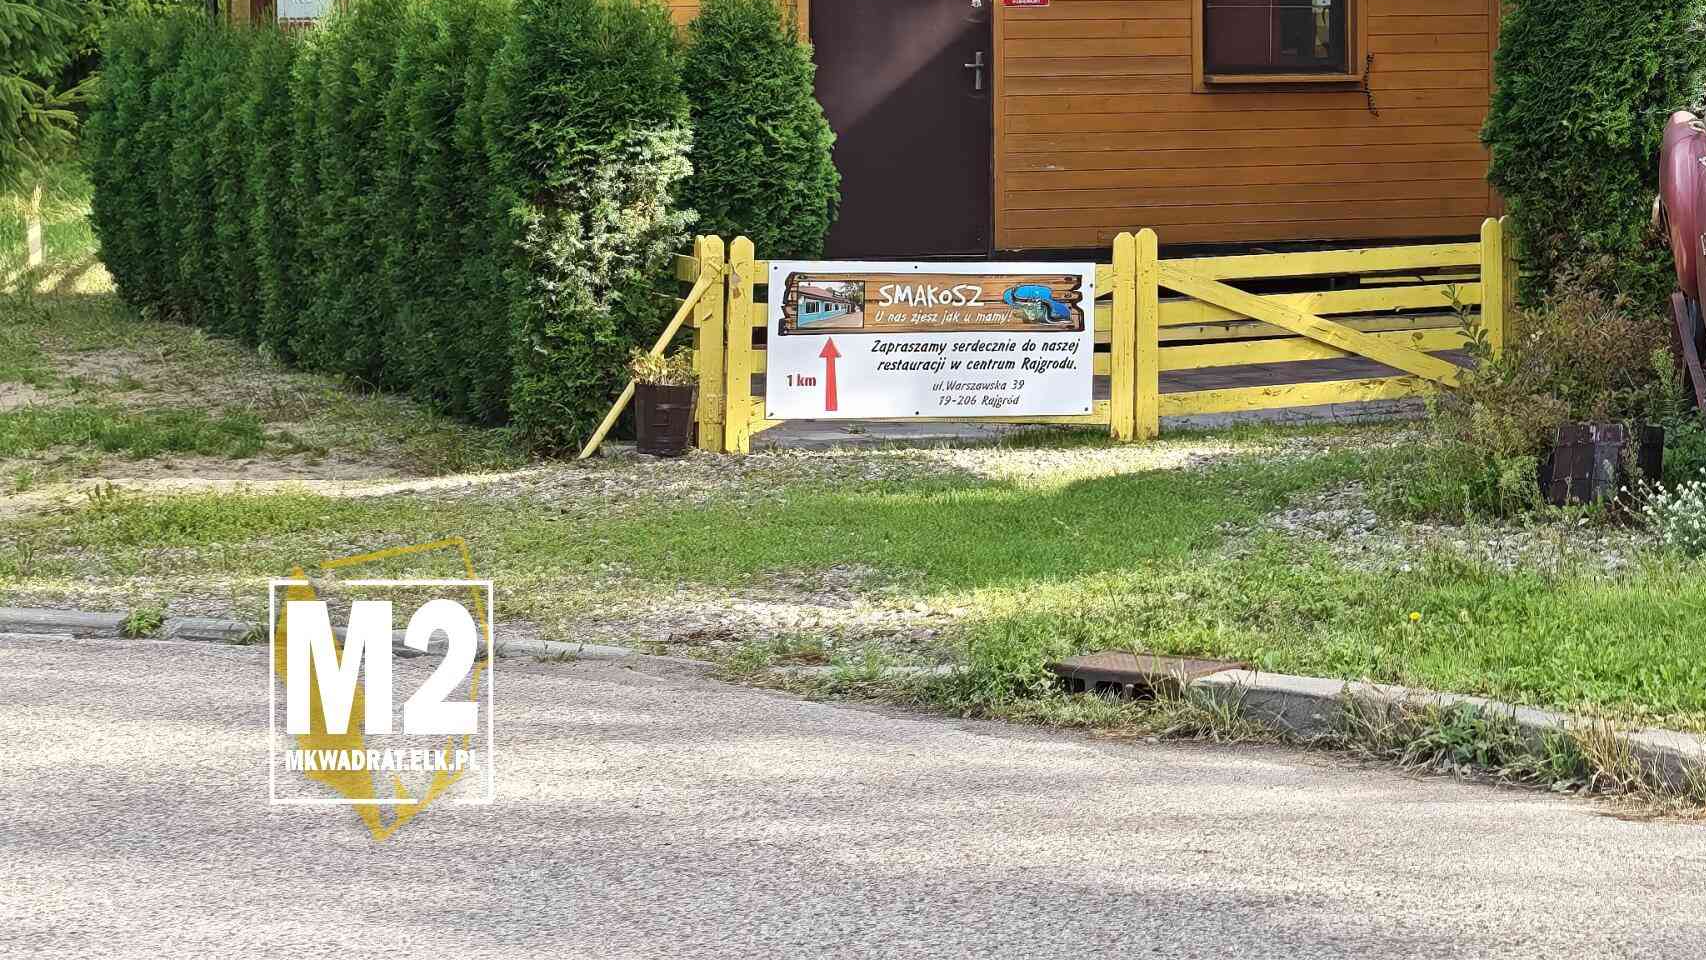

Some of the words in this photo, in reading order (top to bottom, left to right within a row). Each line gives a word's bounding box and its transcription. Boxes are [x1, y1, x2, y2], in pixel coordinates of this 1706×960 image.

[875, 310, 882, 322] U
[888, 313, 907, 322] nas
[911, 311, 938, 324] zjesz
[941, 310, 959, 324] jak
[964, 313, 971, 322] u
[976, 310, 1013, 324] mamy!
[871, 340, 947, 355] Zapraszamy
[952, 339, 1016, 353] serdecznie
[1021, 339, 1036, 352] do
[1041, 338, 1081, 355] naszej
[877, 357, 947, 373] restauracji
[950, 360, 961, 370] w
[966, 358, 1016, 370] centrum
[1021, 356, 1078, 374] Rajgrodu.
[787, 374, 793, 387] 1
[796, 374, 817, 387] km
[1010, 380, 1025, 391] 39
[938, 395, 977, 406] 19-206
[981, 394, 1020, 408] Rajgród
